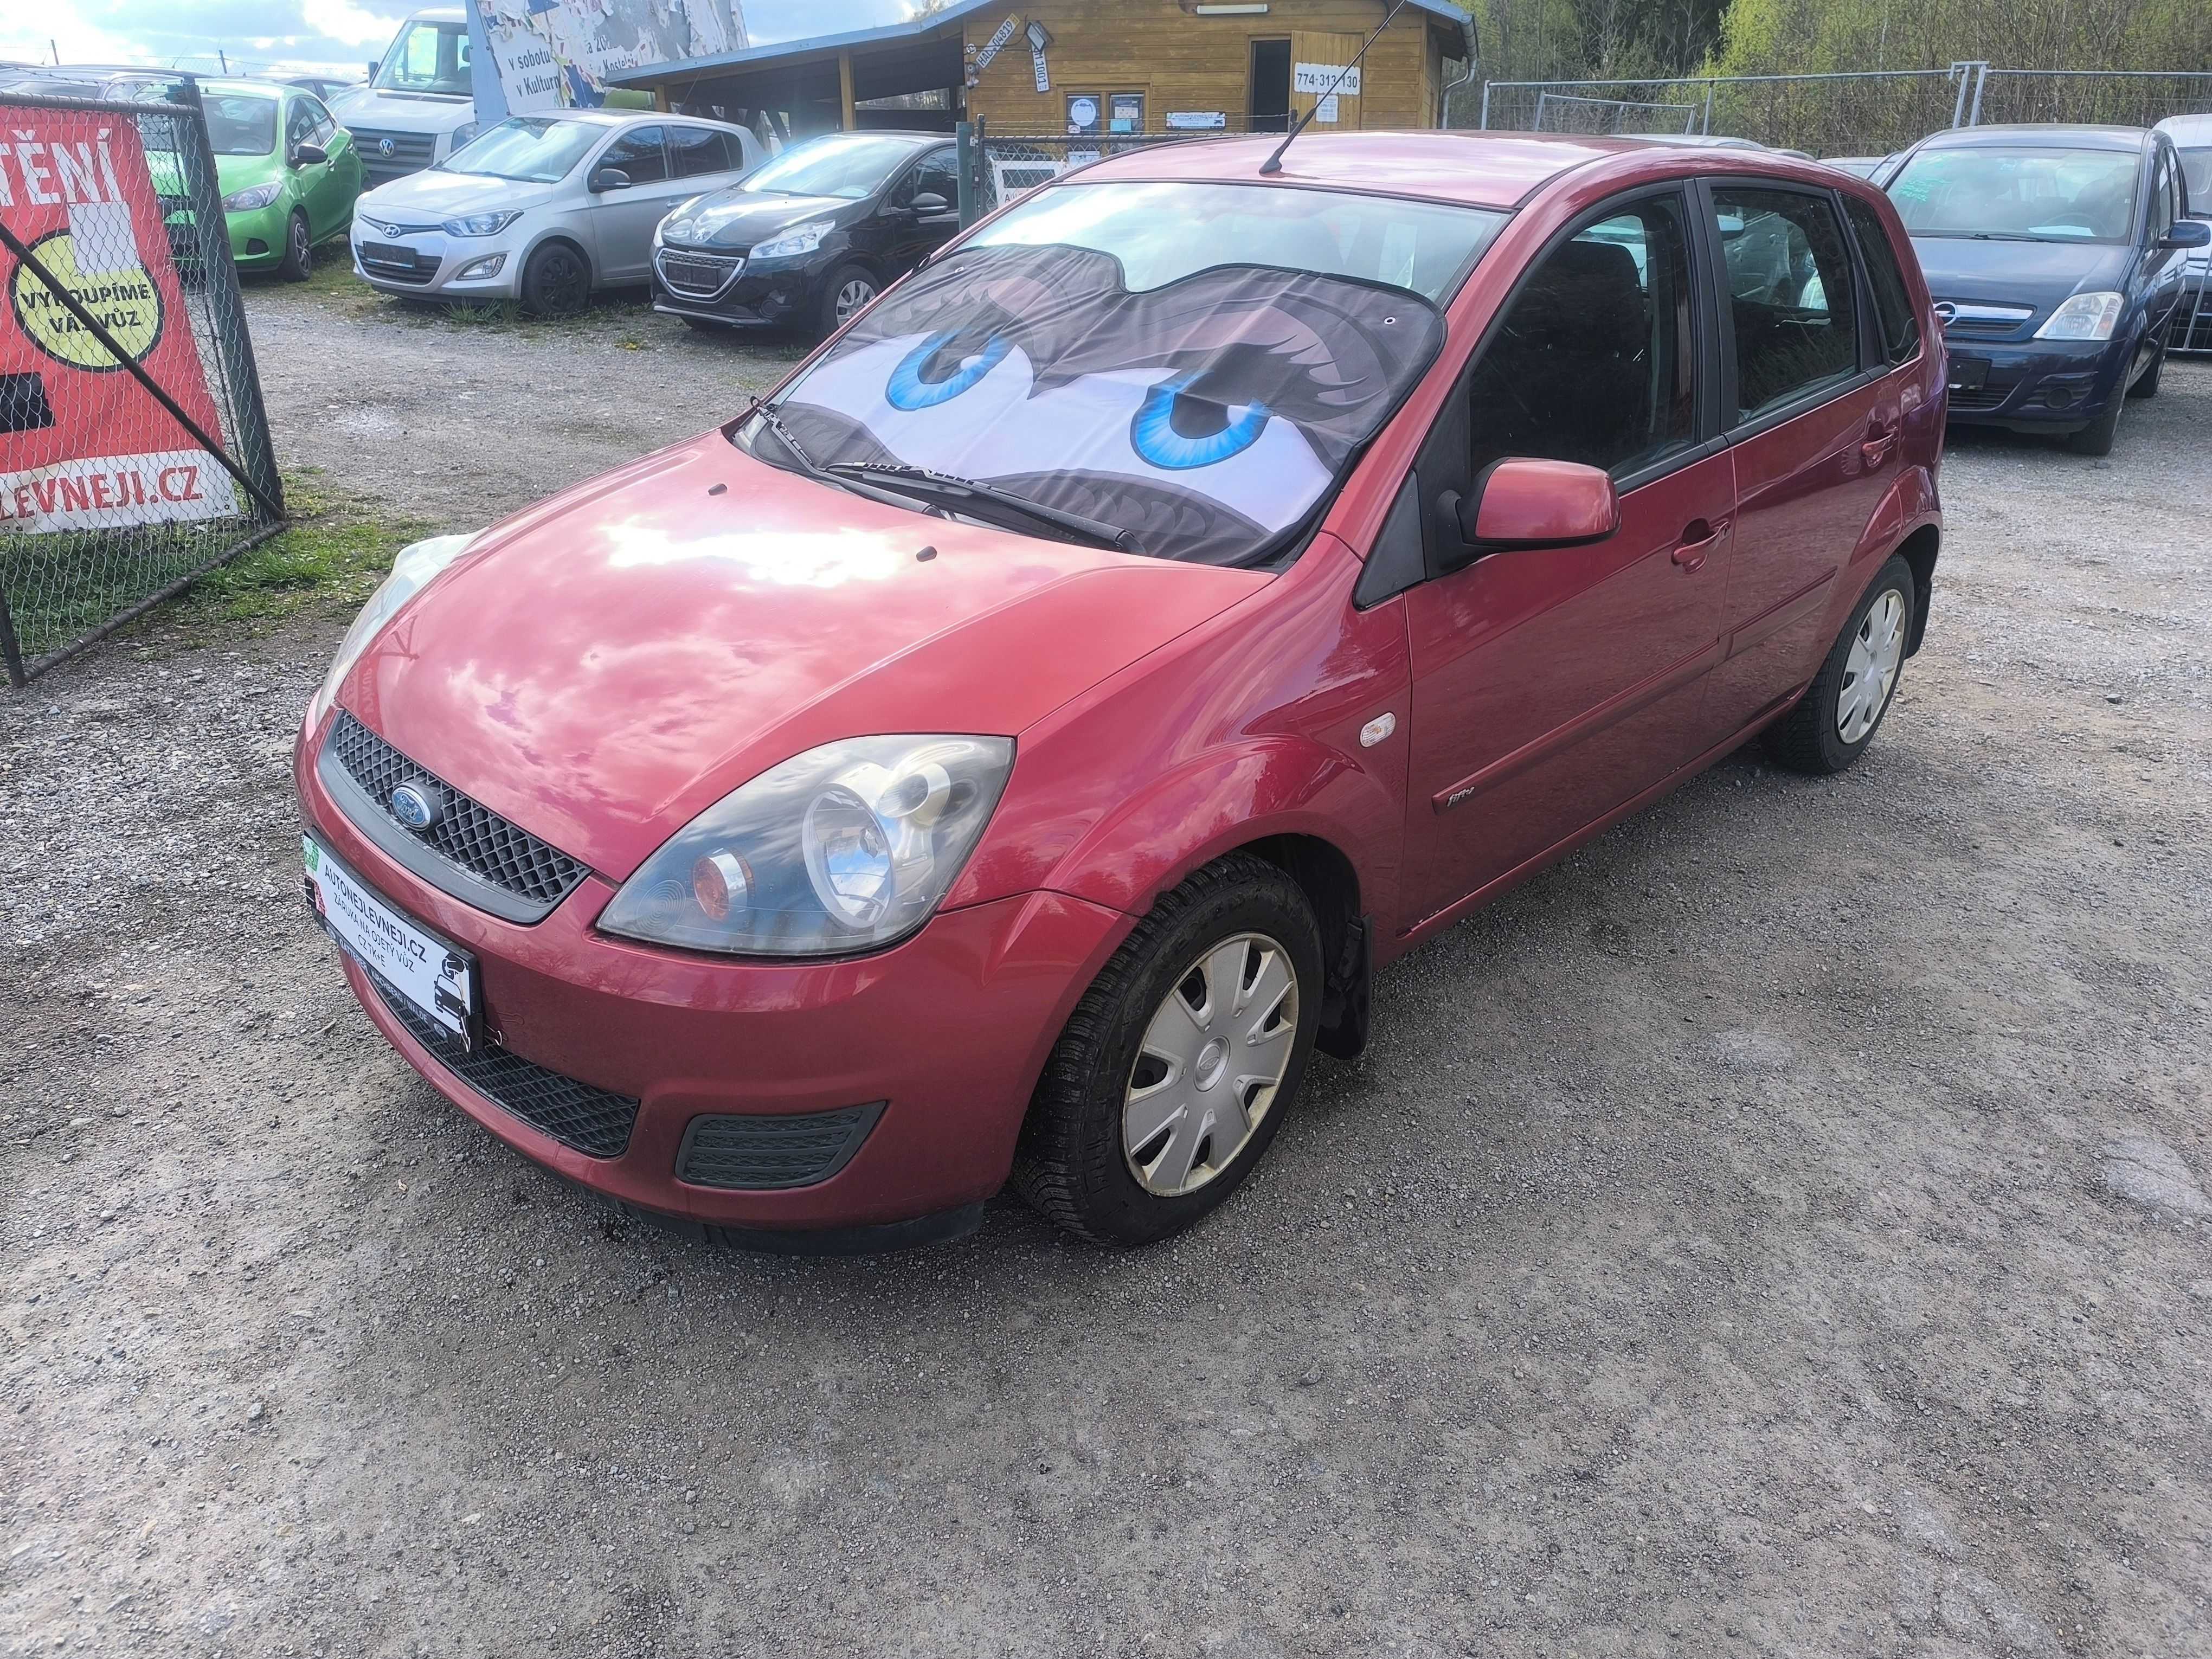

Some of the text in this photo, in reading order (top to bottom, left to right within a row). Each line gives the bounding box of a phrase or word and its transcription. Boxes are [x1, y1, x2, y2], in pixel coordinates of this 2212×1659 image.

[992, 21, 1013, 47] 04819
[508, 47, 551, 70] v sobotu
[1036, 61, 1046, 84] 1001
[1297, 73, 1358, 88] 774-313130
[516, 85, 523, 97] v
[48, 307, 142, 333] VÁ VŮZ
[397, 793, 419, 820] Ford
[325, 864, 427, 963] AUTONEJLEVNEJI.CZ
[333, 892, 359, 927] ZÁRUKA
[360, 918, 371, 937] NA
[371, 930, 395, 957] OJETÝ
[396, 949, 415, 973] VŮZ
[358, 934, 386, 968] CZ TK+E
[406, 999, 428, 1024] WALDE
